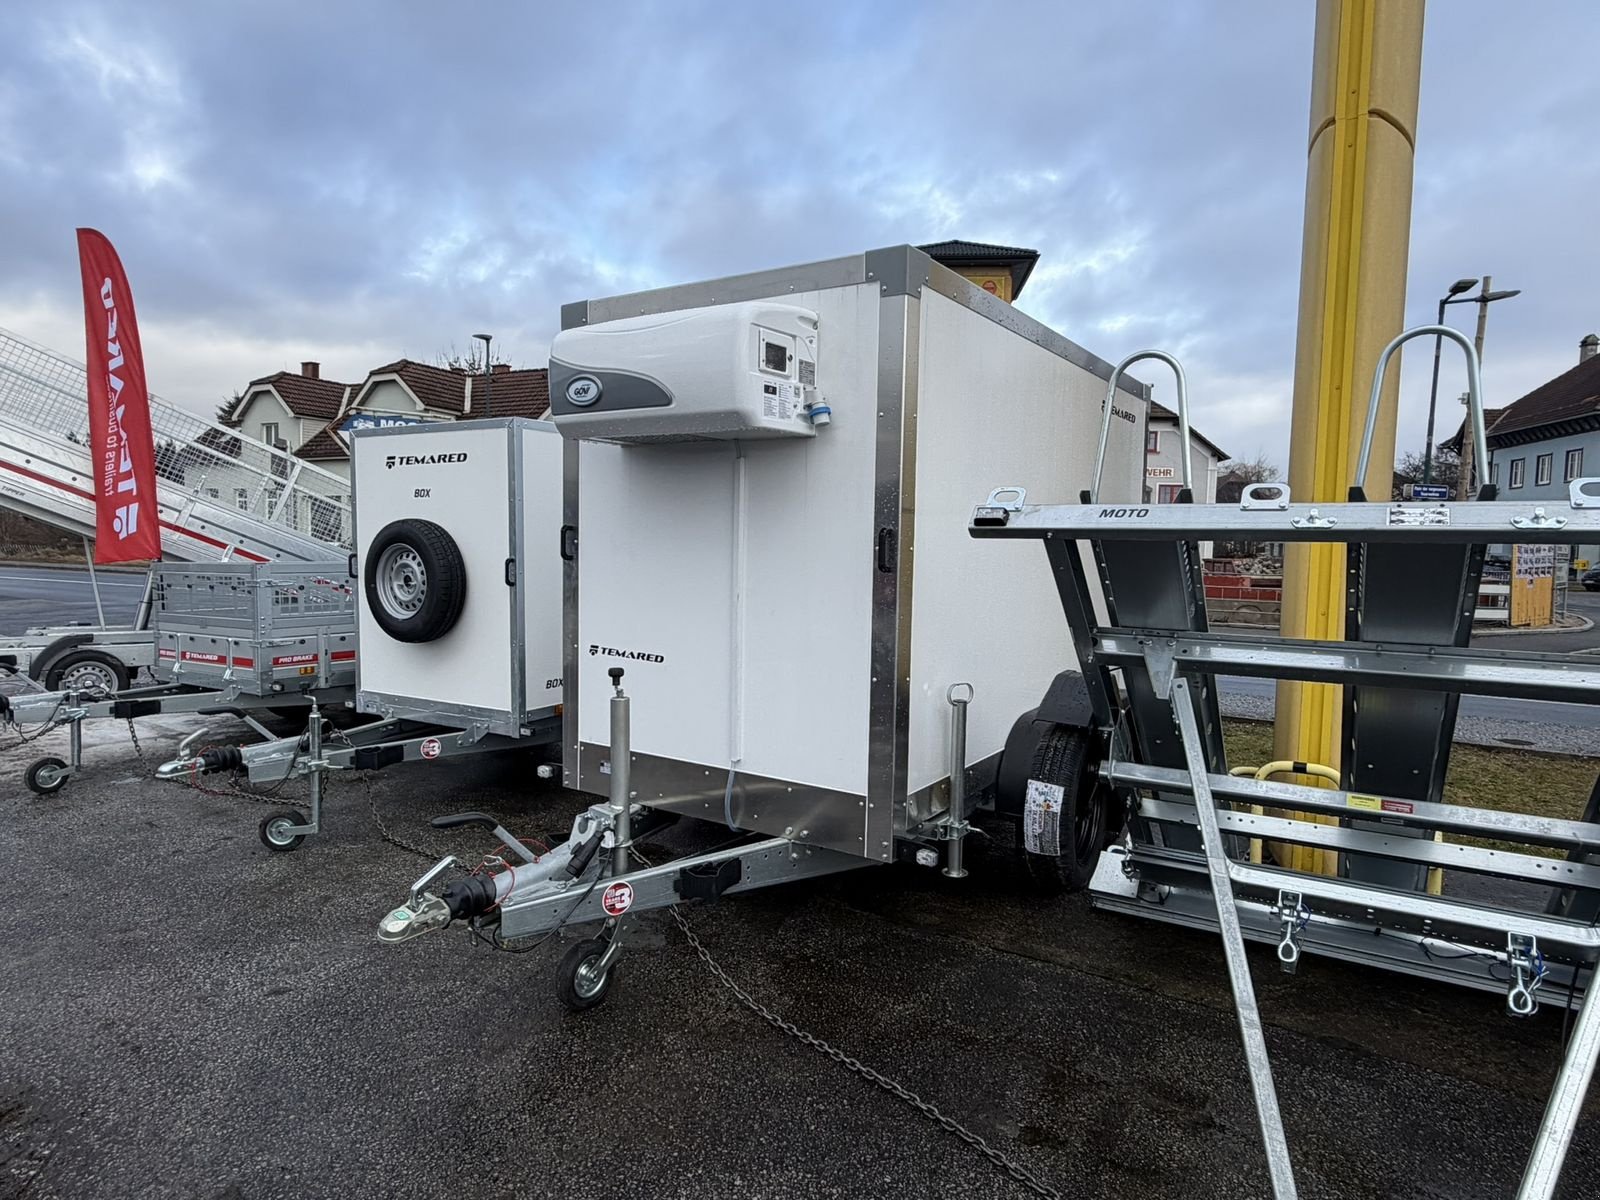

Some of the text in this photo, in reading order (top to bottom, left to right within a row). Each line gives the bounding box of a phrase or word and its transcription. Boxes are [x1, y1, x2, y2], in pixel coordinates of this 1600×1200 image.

[397, 452, 468, 466] TEMARED
[413, 487, 431, 499] BOX
[1098, 508, 1150, 519] MOTO
[190, 651, 219, 661] TEMARED
[278, 654, 314, 664] PRO BRAKE
[600, 645, 665, 664] TEMARED
[545, 678, 564, 690] BOX
[429, 742, 441, 756] 3
[615, 887, 631, 909] 3
